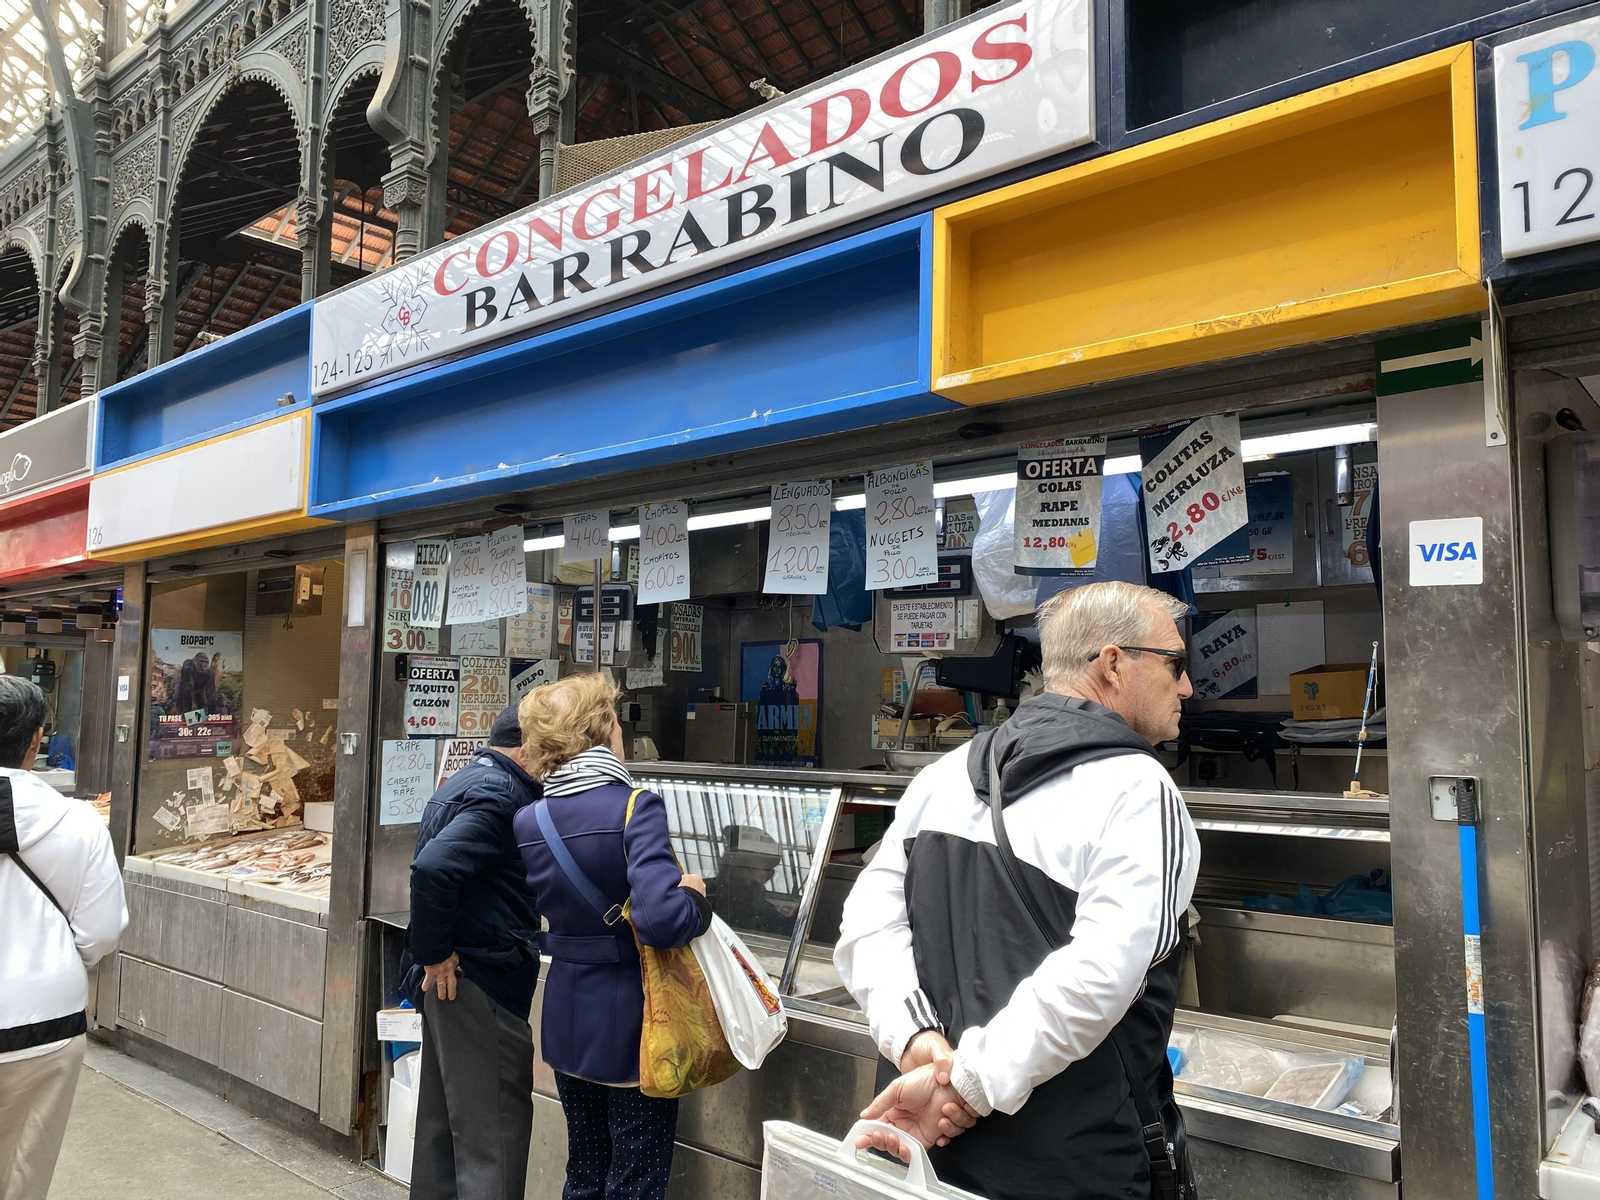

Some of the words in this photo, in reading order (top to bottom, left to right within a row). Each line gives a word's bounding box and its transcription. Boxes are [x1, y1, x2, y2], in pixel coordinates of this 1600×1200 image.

[1516, 40, 1595, 131] P
[433, 16, 1033, 296] CONGELADOS
[463, 107, 985, 334] BARRABINO
[313, 351, 372, 387] 124-125
[1065, 437, 1105, 446] BARRABINO
[1025, 458, 1098, 478] OFERTA
[1146, 430, 1214, 492] COLITAS
[868, 466, 930, 489] ALBÓNDIGAS
[1038, 480, 1082, 493] COLAS
[1152, 446, 1235, 517] MERLUZA
[773, 484, 832, 500] LENGUADOS
[882, 486, 908, 496] POLLO
[645, 505, 678, 520] CHOPOS
[874, 496, 916, 526] 2,80
[1040, 501, 1078, 512] RAPE
[571, 513, 597, 525] TIRAS
[777, 503, 820, 532] 8,50
[947, 513, 966, 523] DAS
[1032, 518, 1090, 528] MEDIANAS
[1166, 492, 1220, 542] 2,80
[88, 526, 102, 546] 126
[487, 535, 510, 548] FILETES
[571, 527, 600, 550] 4,40
[645, 523, 676, 550] 4,00
[870, 526, 924, 548] NUGGETS
[1024, 537, 1065, 550] 12,80
[416, 544, 448, 566] HIELO
[489, 546, 515, 562] ROSADA
[643, 551, 680, 566] CHOPITOS
[1415, 542, 1477, 562] VISA
[453, 556, 479, 579] 6,80
[490, 559, 516, 586] 6,80
[644, 564, 675, 590] 6,00
[873, 556, 916, 583] 3,00
[912, 602, 953, 610] ESTABLECIMIENTO
[387, 628, 425, 650] 3,00
[459, 633, 486, 650] 1,75
[1200, 624, 1247, 660] RAYA
[462, 657, 507, 668] COLITAS
[1212, 656, 1239, 678] 6,80
[411, 668, 455, 680] OFERTA
[516, 669, 544, 690] PULPO
[409, 684, 455, 693] TAQUITO
[413, 697, 450, 708] CAZÓN
[461, 694, 506, 704] MERLUZAS
[407, 716, 436, 728] 4,60
[755, 705, 813, 730] ARMEN
[395, 741, 421, 752] RAPE
[387, 776, 420, 786] CABEZA
[394, 788, 415, 797] RAPE
[389, 798, 423, 816] 5,80
